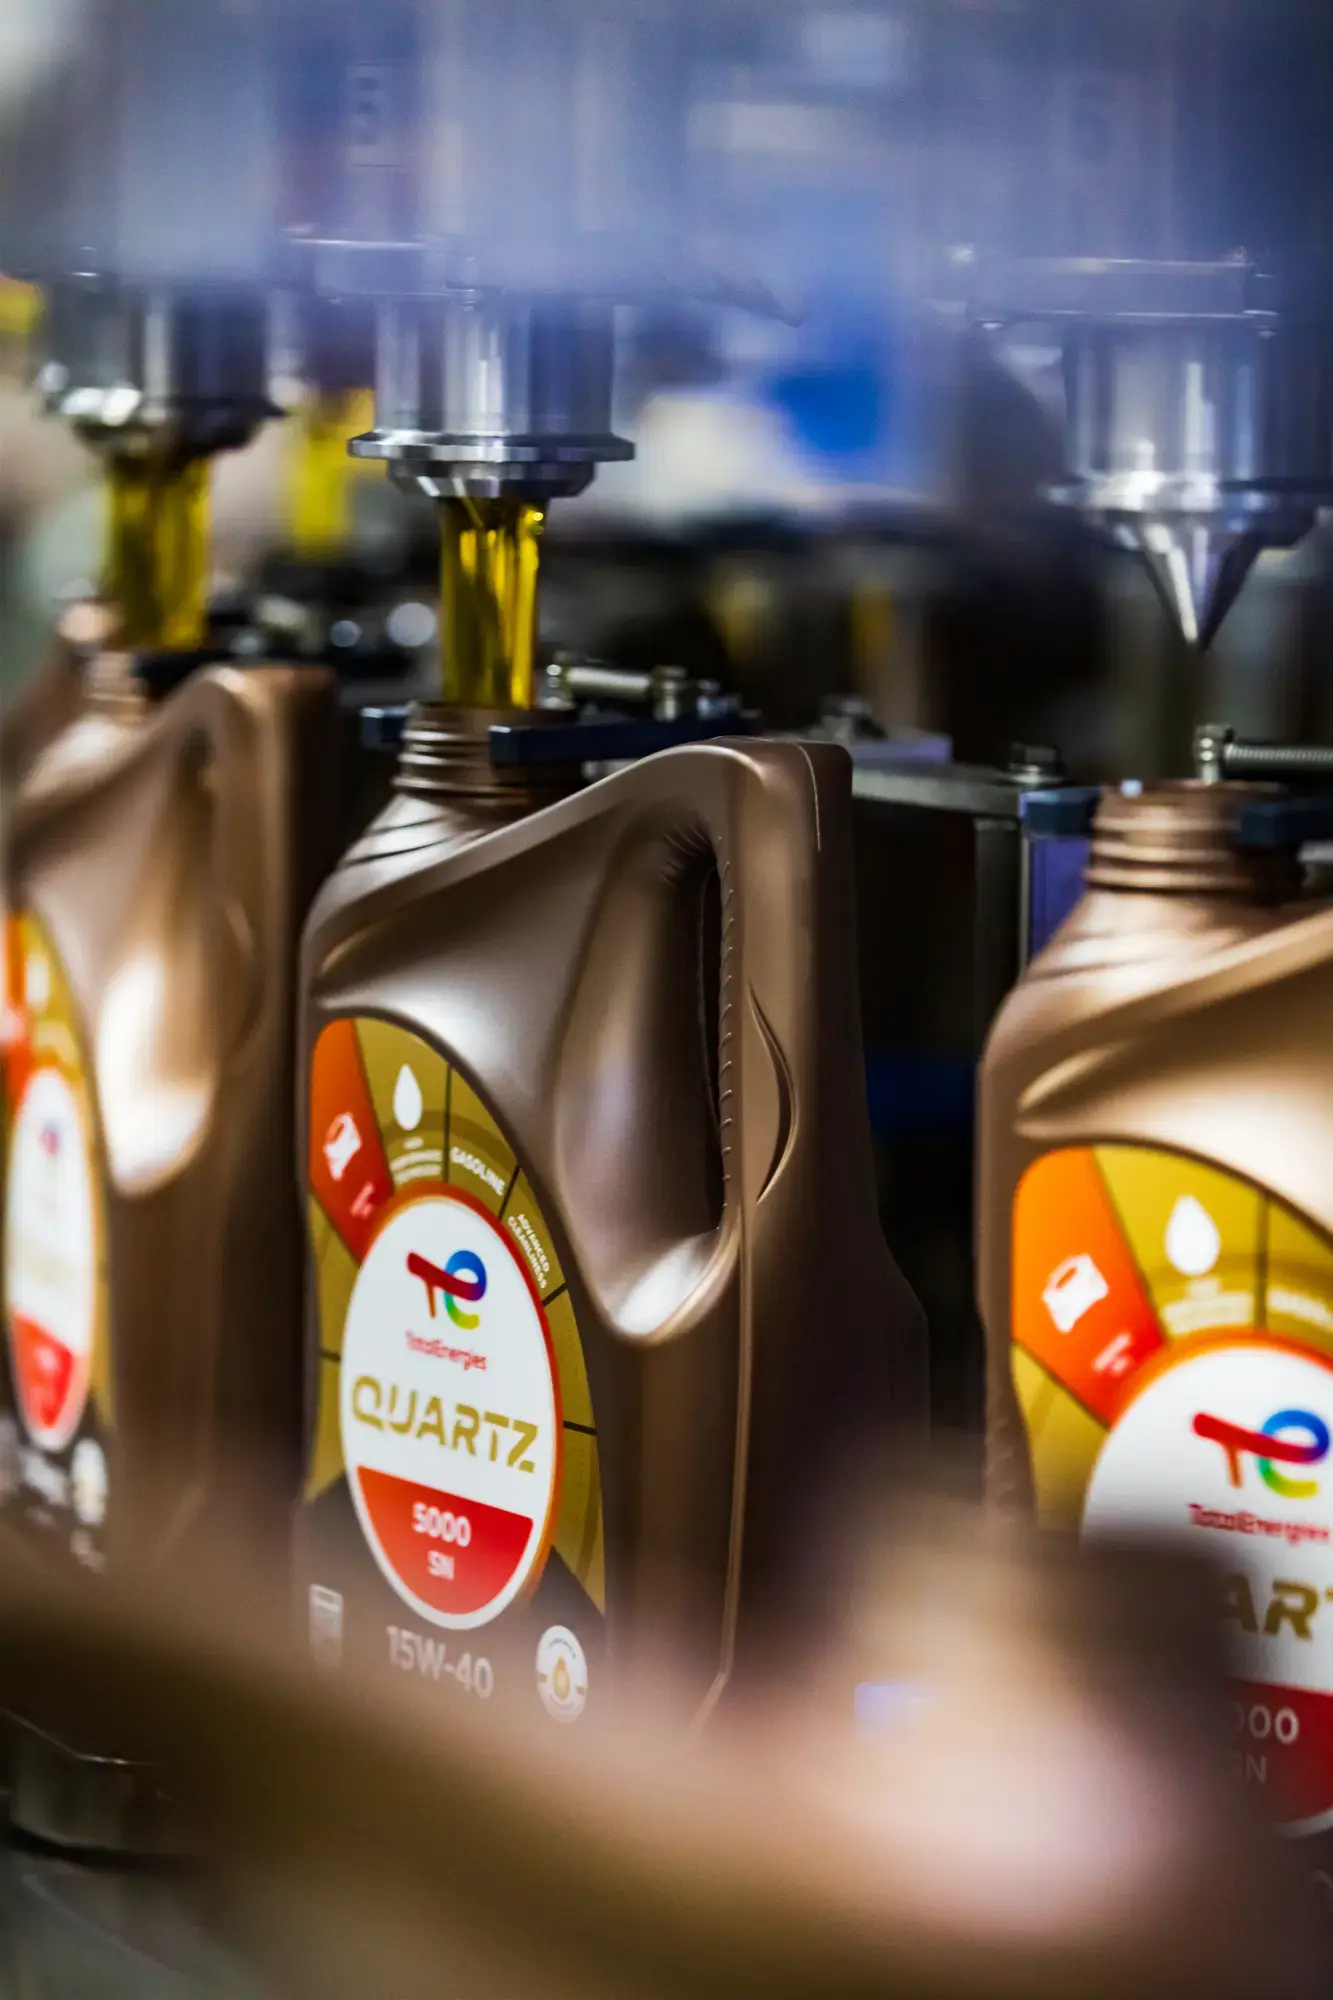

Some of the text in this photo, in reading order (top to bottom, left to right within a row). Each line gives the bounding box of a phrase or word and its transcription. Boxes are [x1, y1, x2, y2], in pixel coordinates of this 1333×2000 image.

[451, 1146, 505, 1196] GASOLINE
[508, 1216, 547, 1289] CLEANLINESS
[517, 1214, 550, 1272] ADVANCED
[352, 1375, 538, 1473] QUARTZ
[413, 1502, 471, 1548] 5000
[428, 1550, 455, 1581] SN
[1221, 1572, 1333, 1641] AR
[386, 1625, 494, 1700] 15W-40
